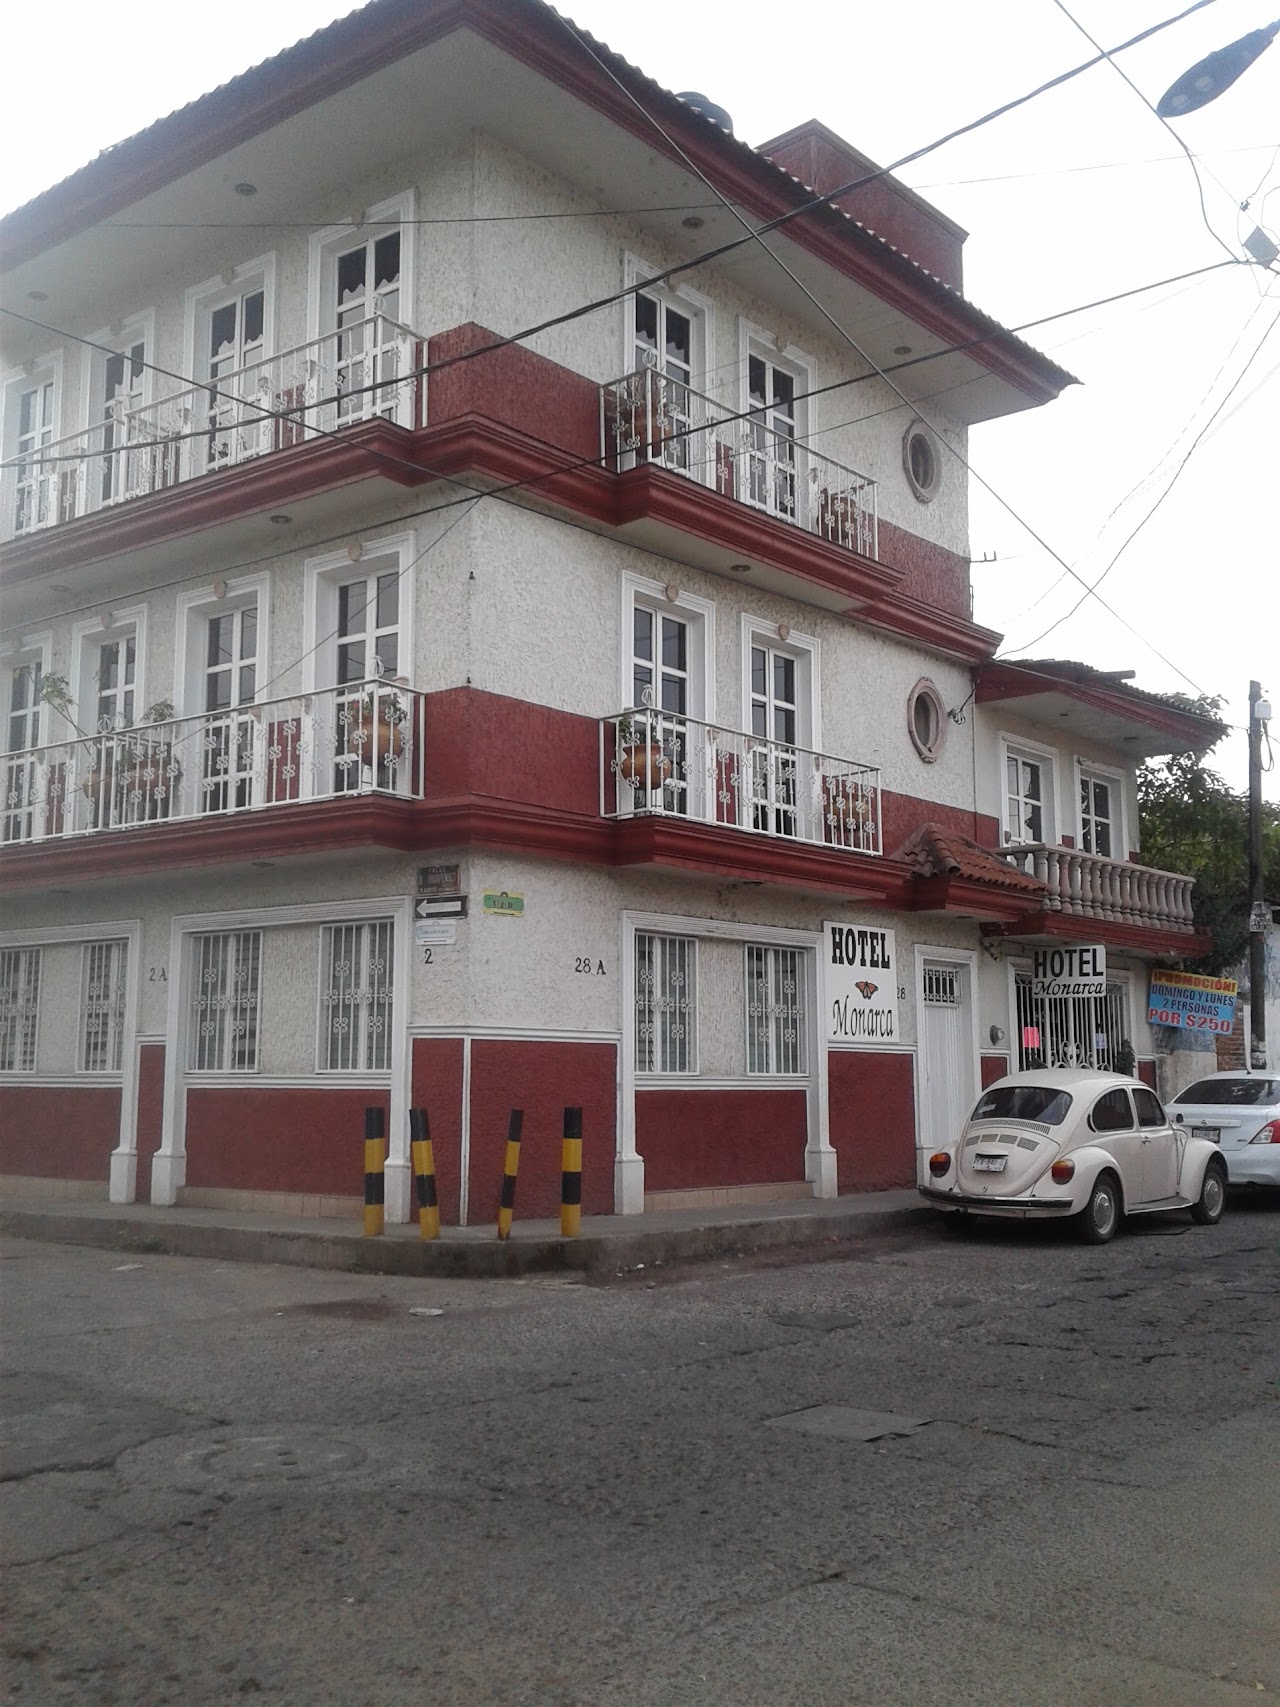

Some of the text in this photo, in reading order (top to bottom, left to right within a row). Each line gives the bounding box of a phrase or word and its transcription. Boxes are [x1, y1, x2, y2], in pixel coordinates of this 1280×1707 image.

[424, 948, 434, 964] 2
[831, 926, 891, 969] HOTEL
[575, 957, 607, 975] 28 A
[1034, 948, 1104, 978] HOTEL
[1033, 978, 1105, 996] Monarca
[1151, 984, 1234, 1007] DOMINGO Y LUNES
[832, 994, 895, 1037] Monarca
[1162, 998, 1220, 1016] 2 PERSONAS
[1149, 1008, 1231, 1033] POR $250
